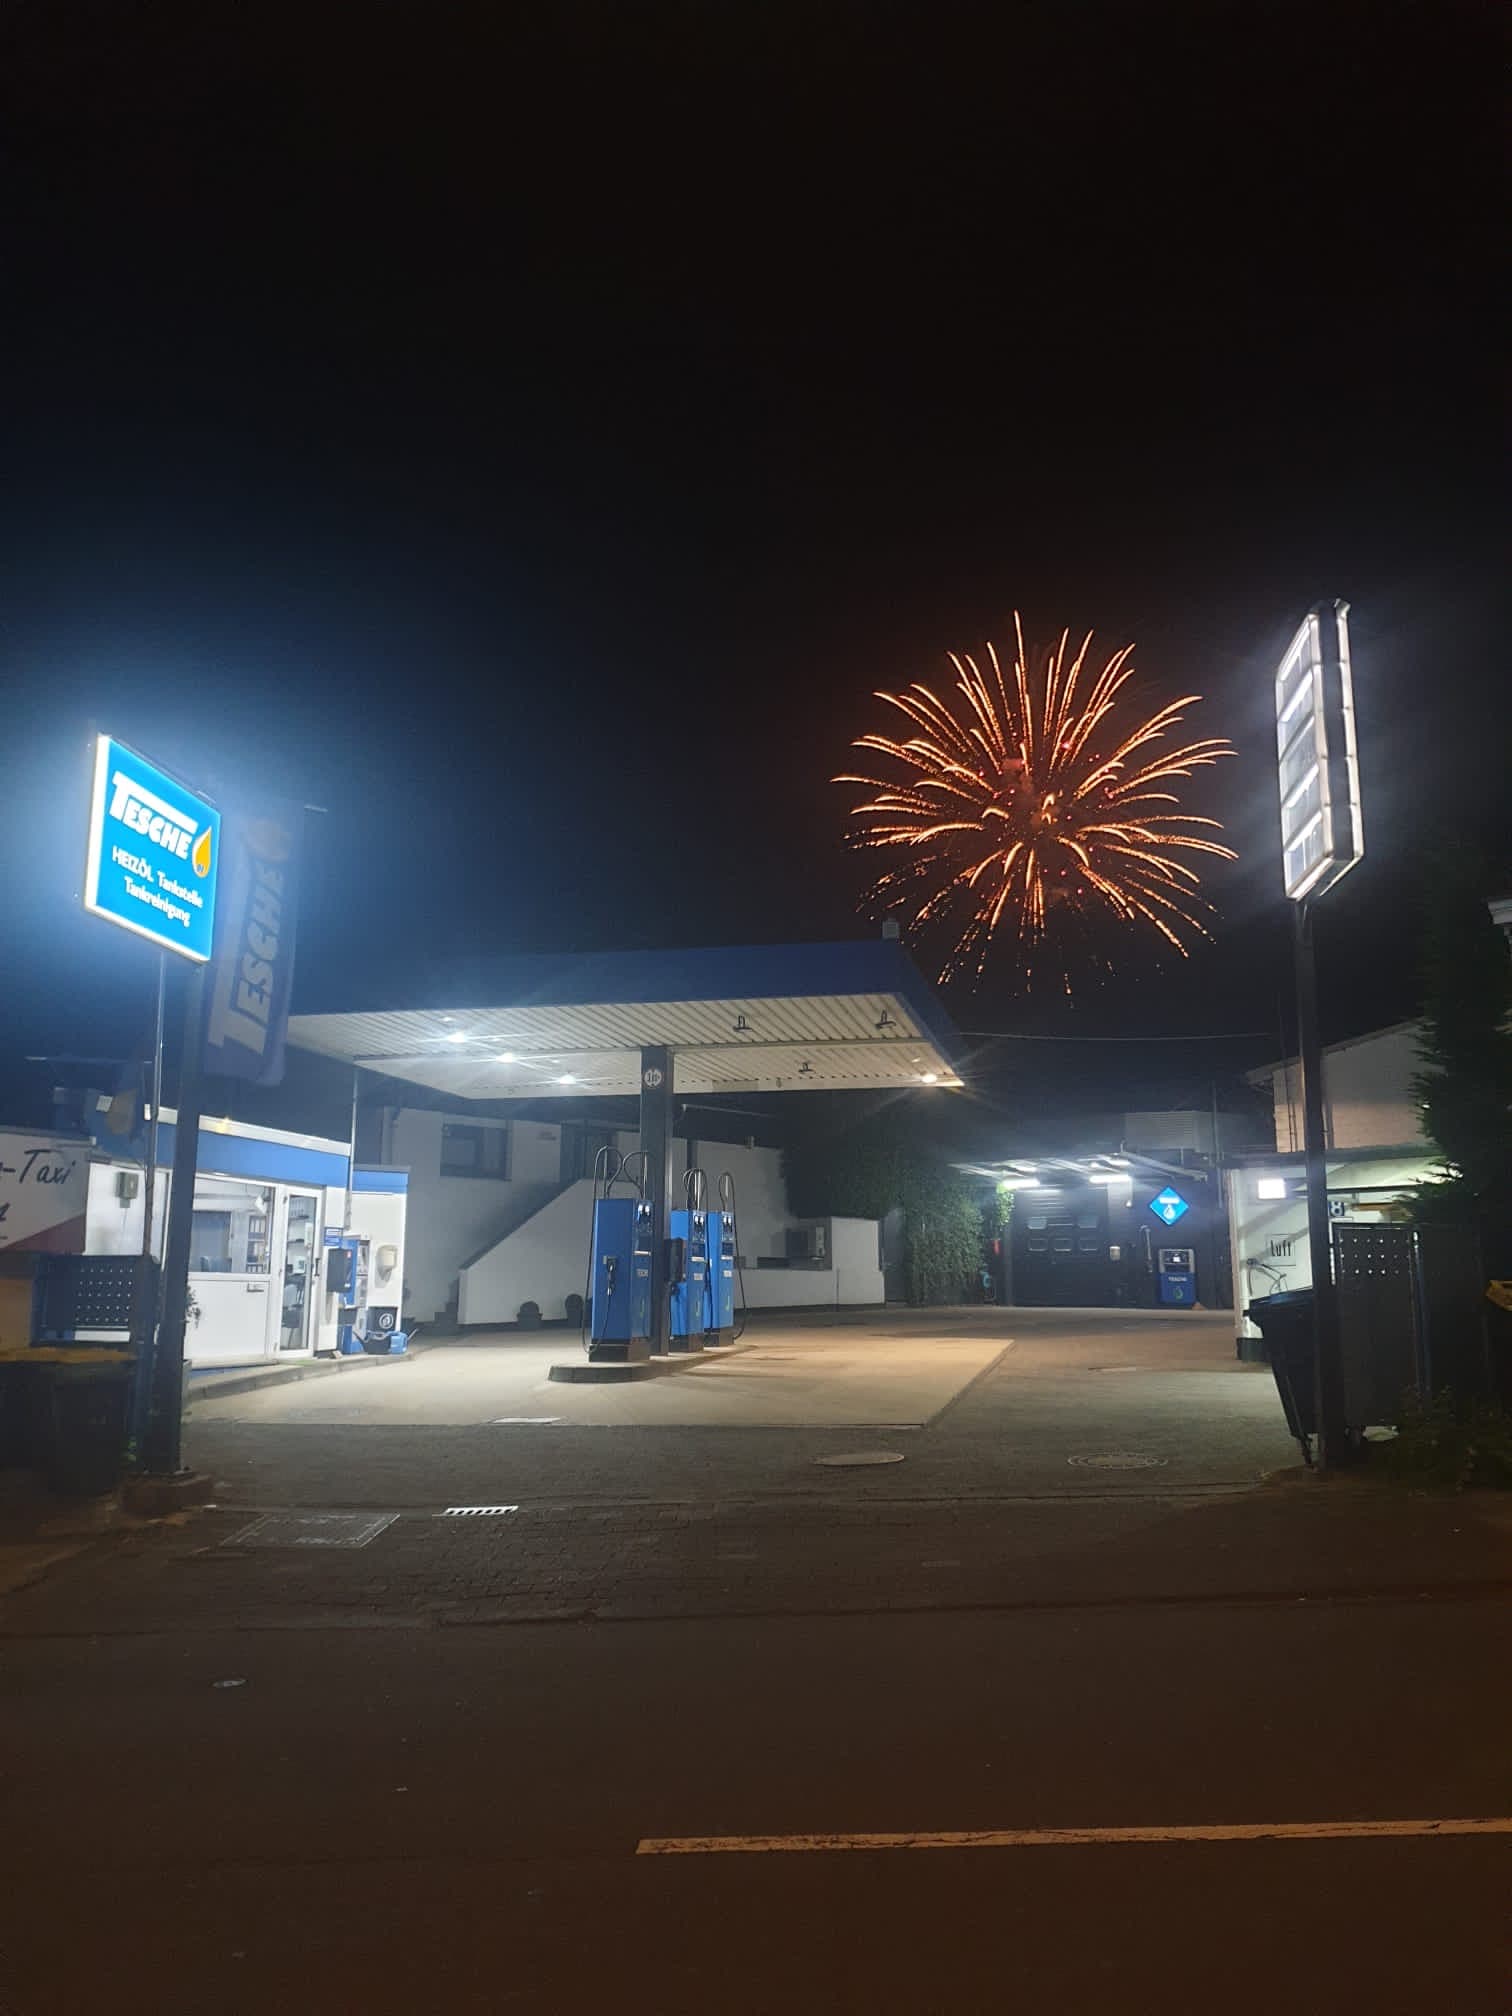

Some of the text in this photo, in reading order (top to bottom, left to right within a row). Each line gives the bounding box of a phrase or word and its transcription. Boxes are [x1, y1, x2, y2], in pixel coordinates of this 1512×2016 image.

[109, 770, 198, 860] TESCHE
[124, 876, 190, 928] Tankreinigung
[157, 871, 203, 908] Tankstelle
[208, 855, 285, 1055] TESCHE
[0, 1148, 76, 1184] -Taxi
